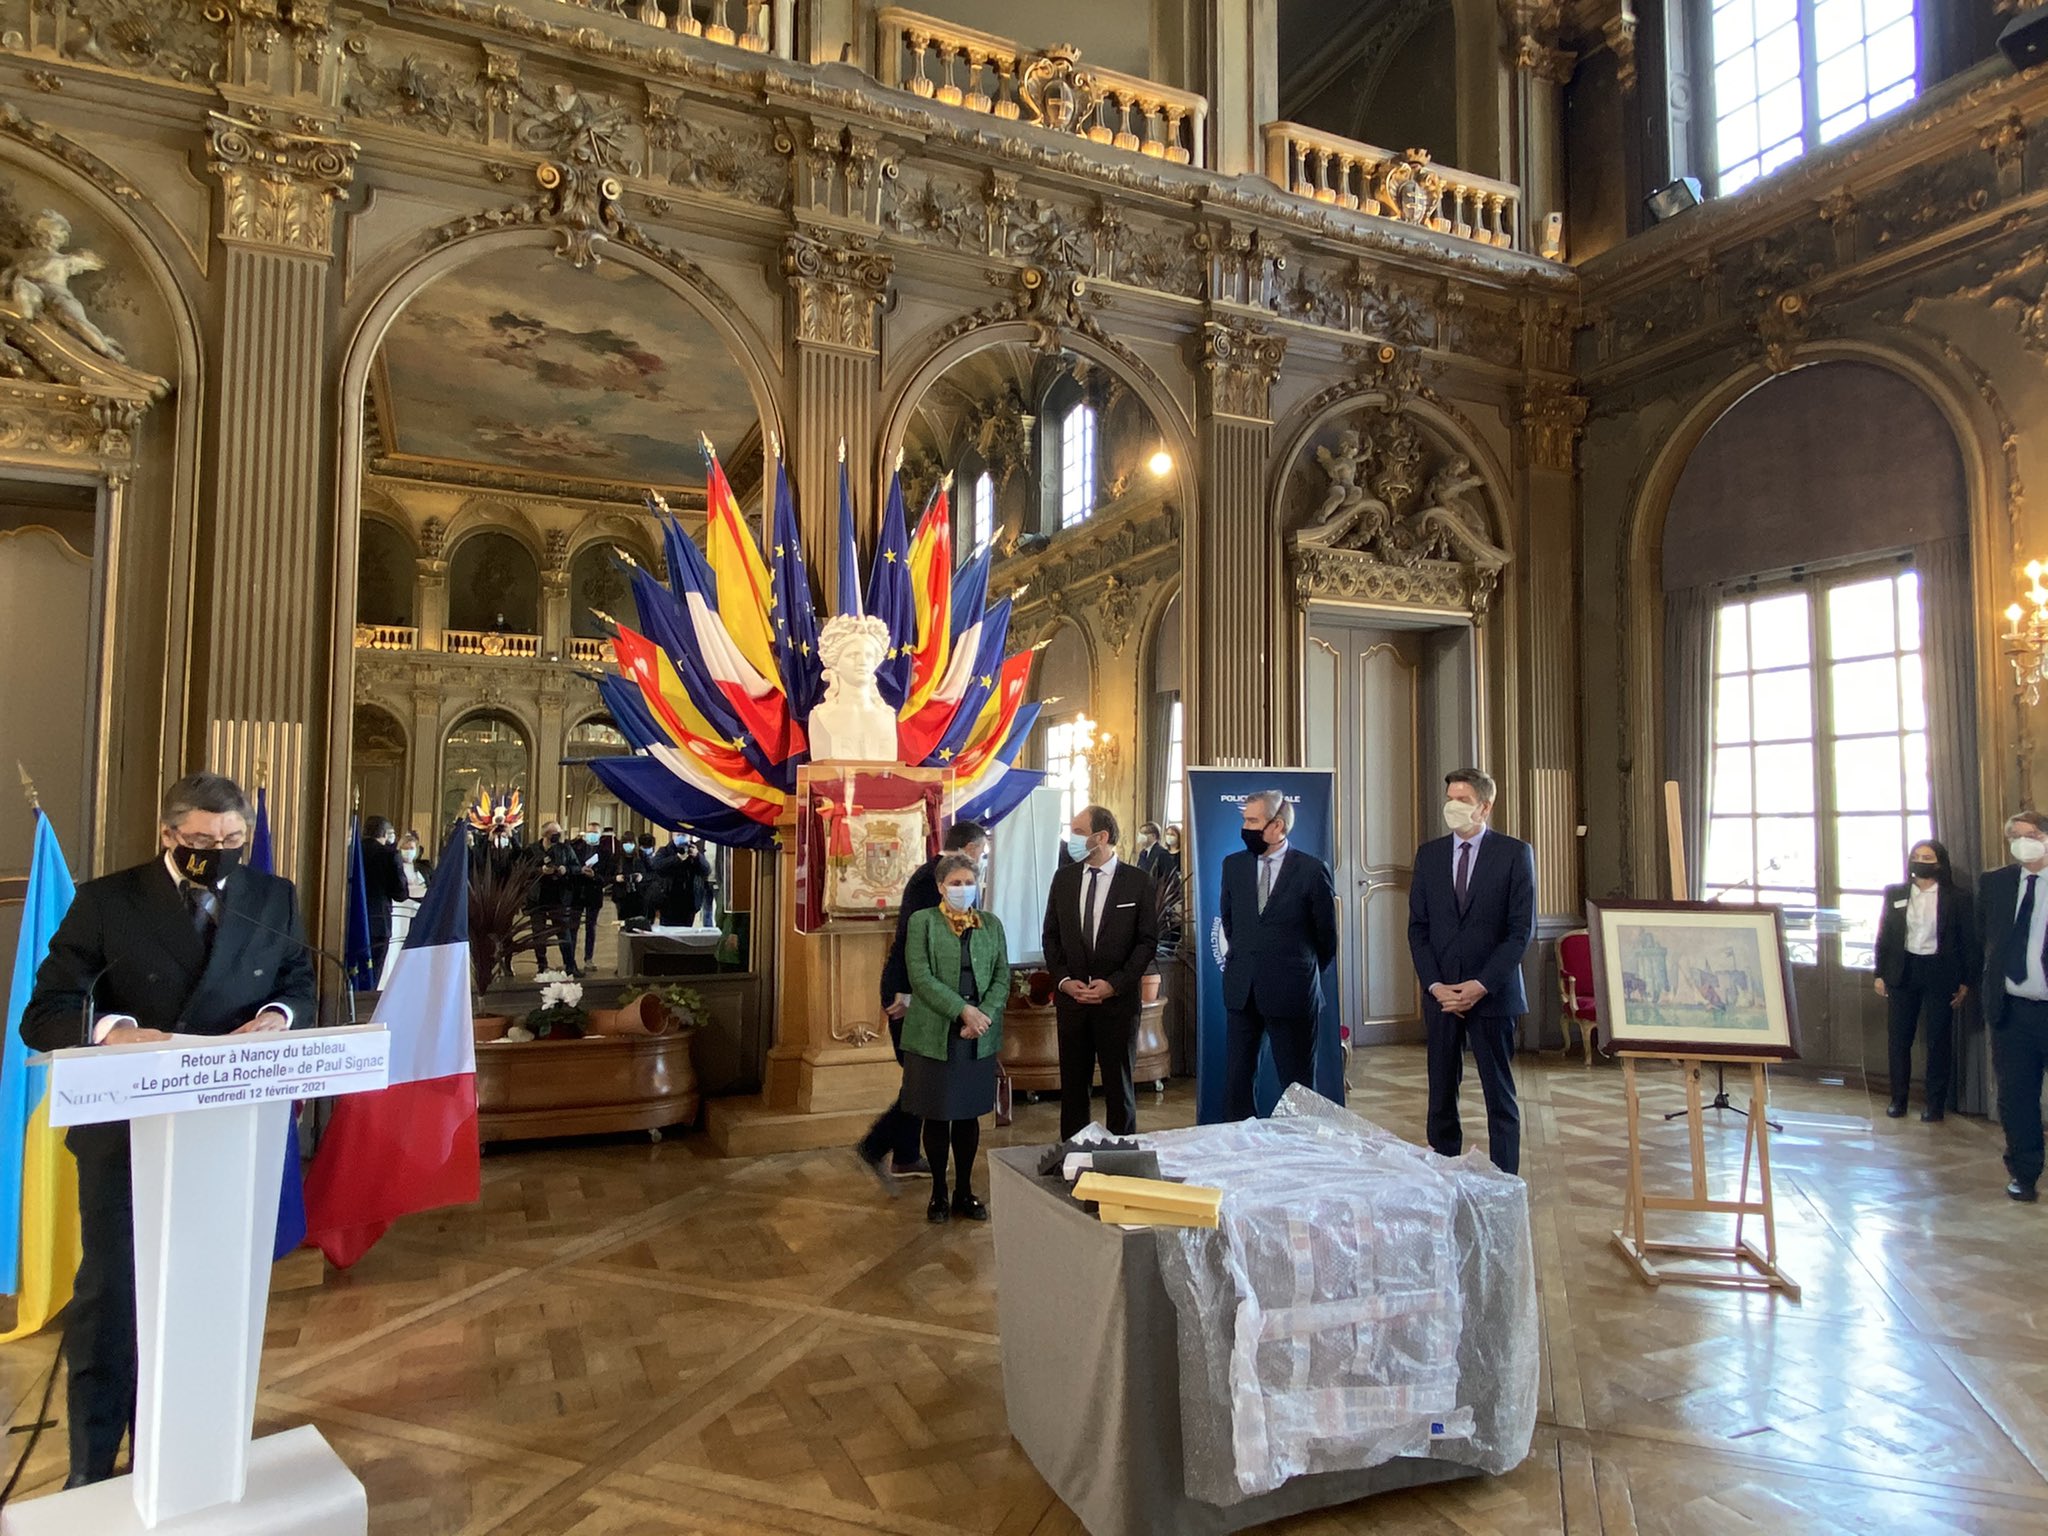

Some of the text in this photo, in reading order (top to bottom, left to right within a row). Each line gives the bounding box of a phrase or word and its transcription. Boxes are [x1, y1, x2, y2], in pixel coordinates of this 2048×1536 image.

[1210, 916, 1223, 965] DIRECTION
[181, 1041, 346, 1068] Retour à Nancy du tableau
[161, 1073, 190, 1091] port
[193, 1071, 210, 1086] de
[213, 1068, 229, 1084] La
[297, 1060, 313, 1075] de
[316, 1057, 343, 1073] Paul
[345, 1055, 384, 1071] Signac
[58, 1089, 128, 1107] Nancy
[197, 1081, 327, 1104] Vendredi 12 février 2021
